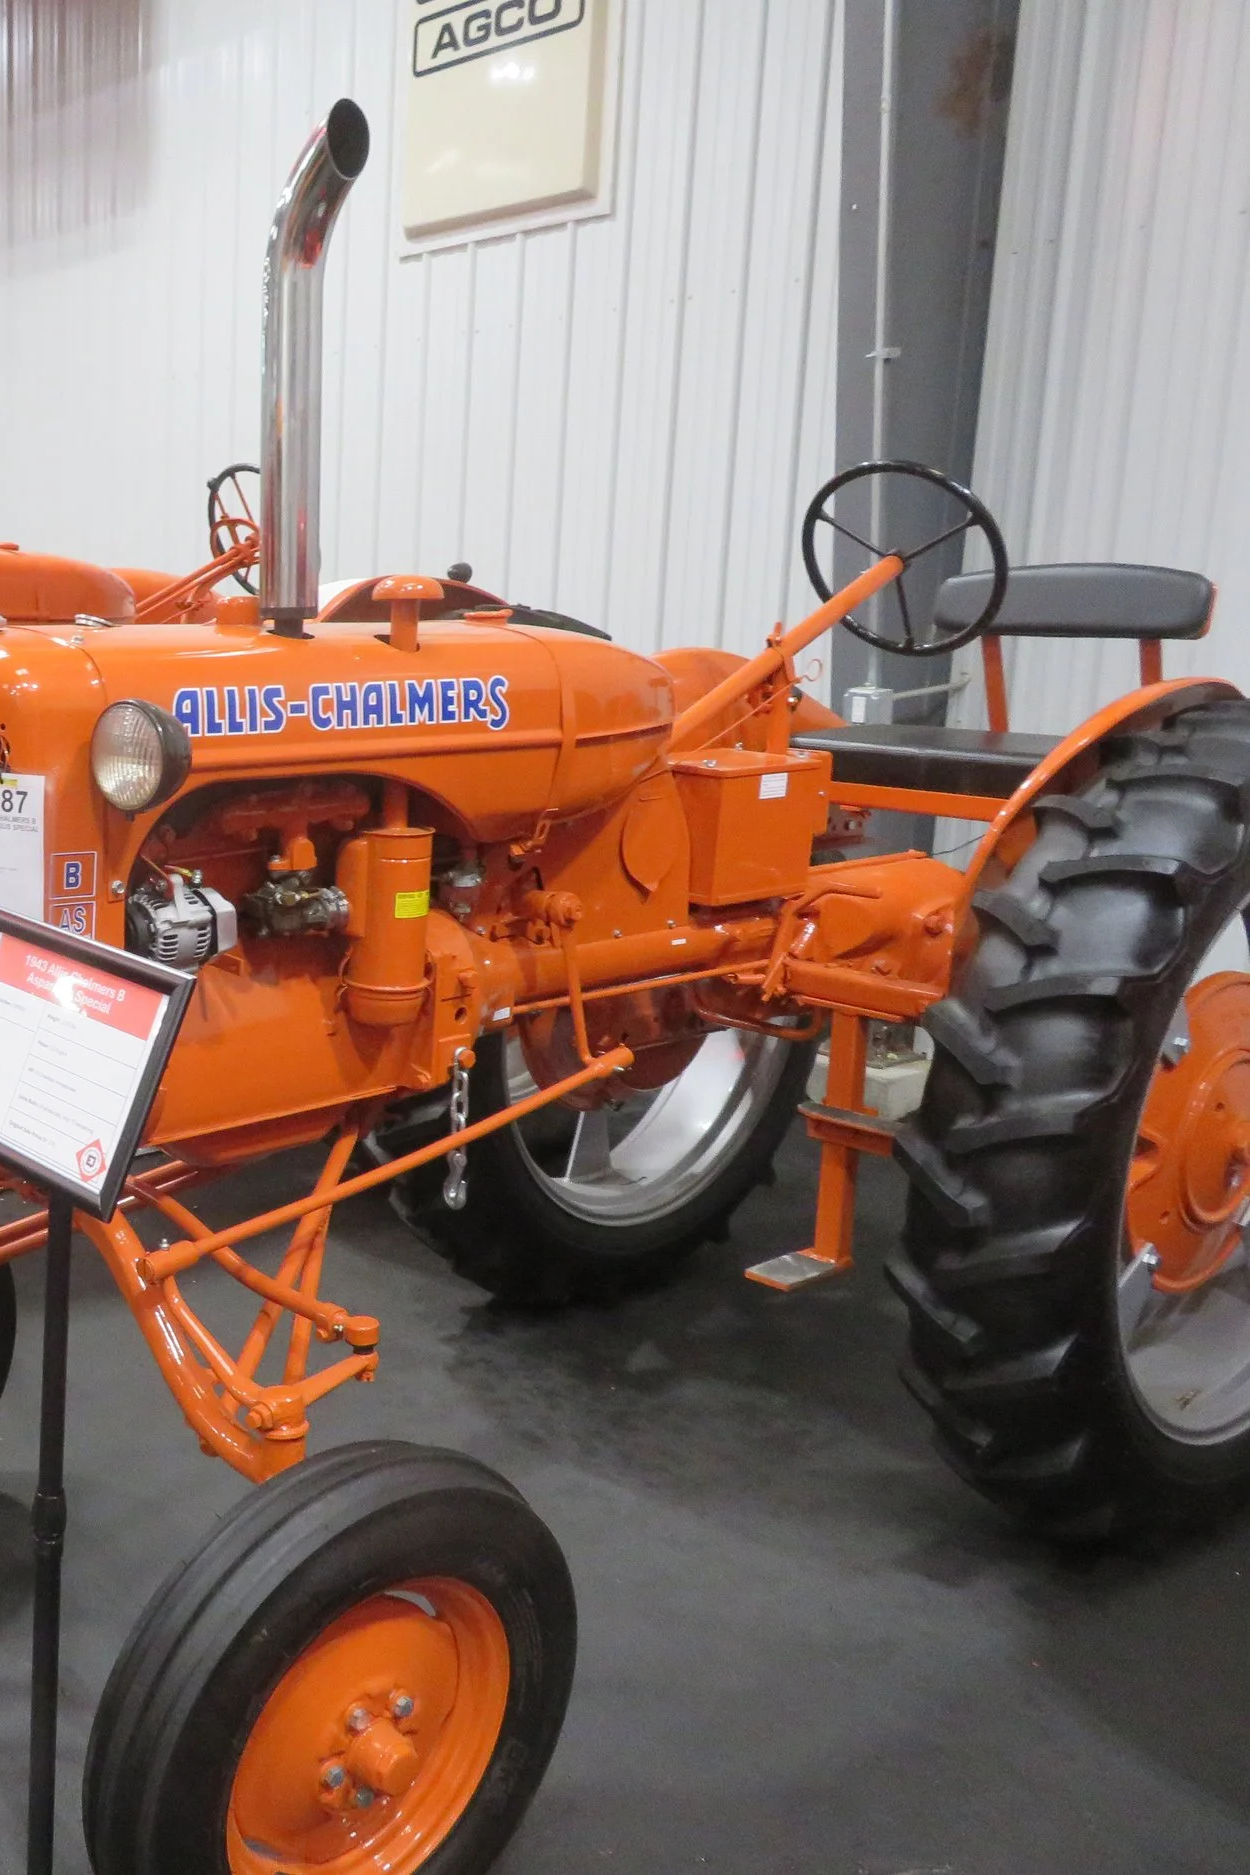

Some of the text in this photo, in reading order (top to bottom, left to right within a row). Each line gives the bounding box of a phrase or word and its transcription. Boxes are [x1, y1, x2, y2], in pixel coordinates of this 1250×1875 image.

[430, 0, 562, 60] AGCO
[172, 675, 509, 738] ALLIS-CHALMERS
[64, 861, 82, 890] B
[60, 906, 87, 934] AS
[74, 989, 112, 1015] Special
